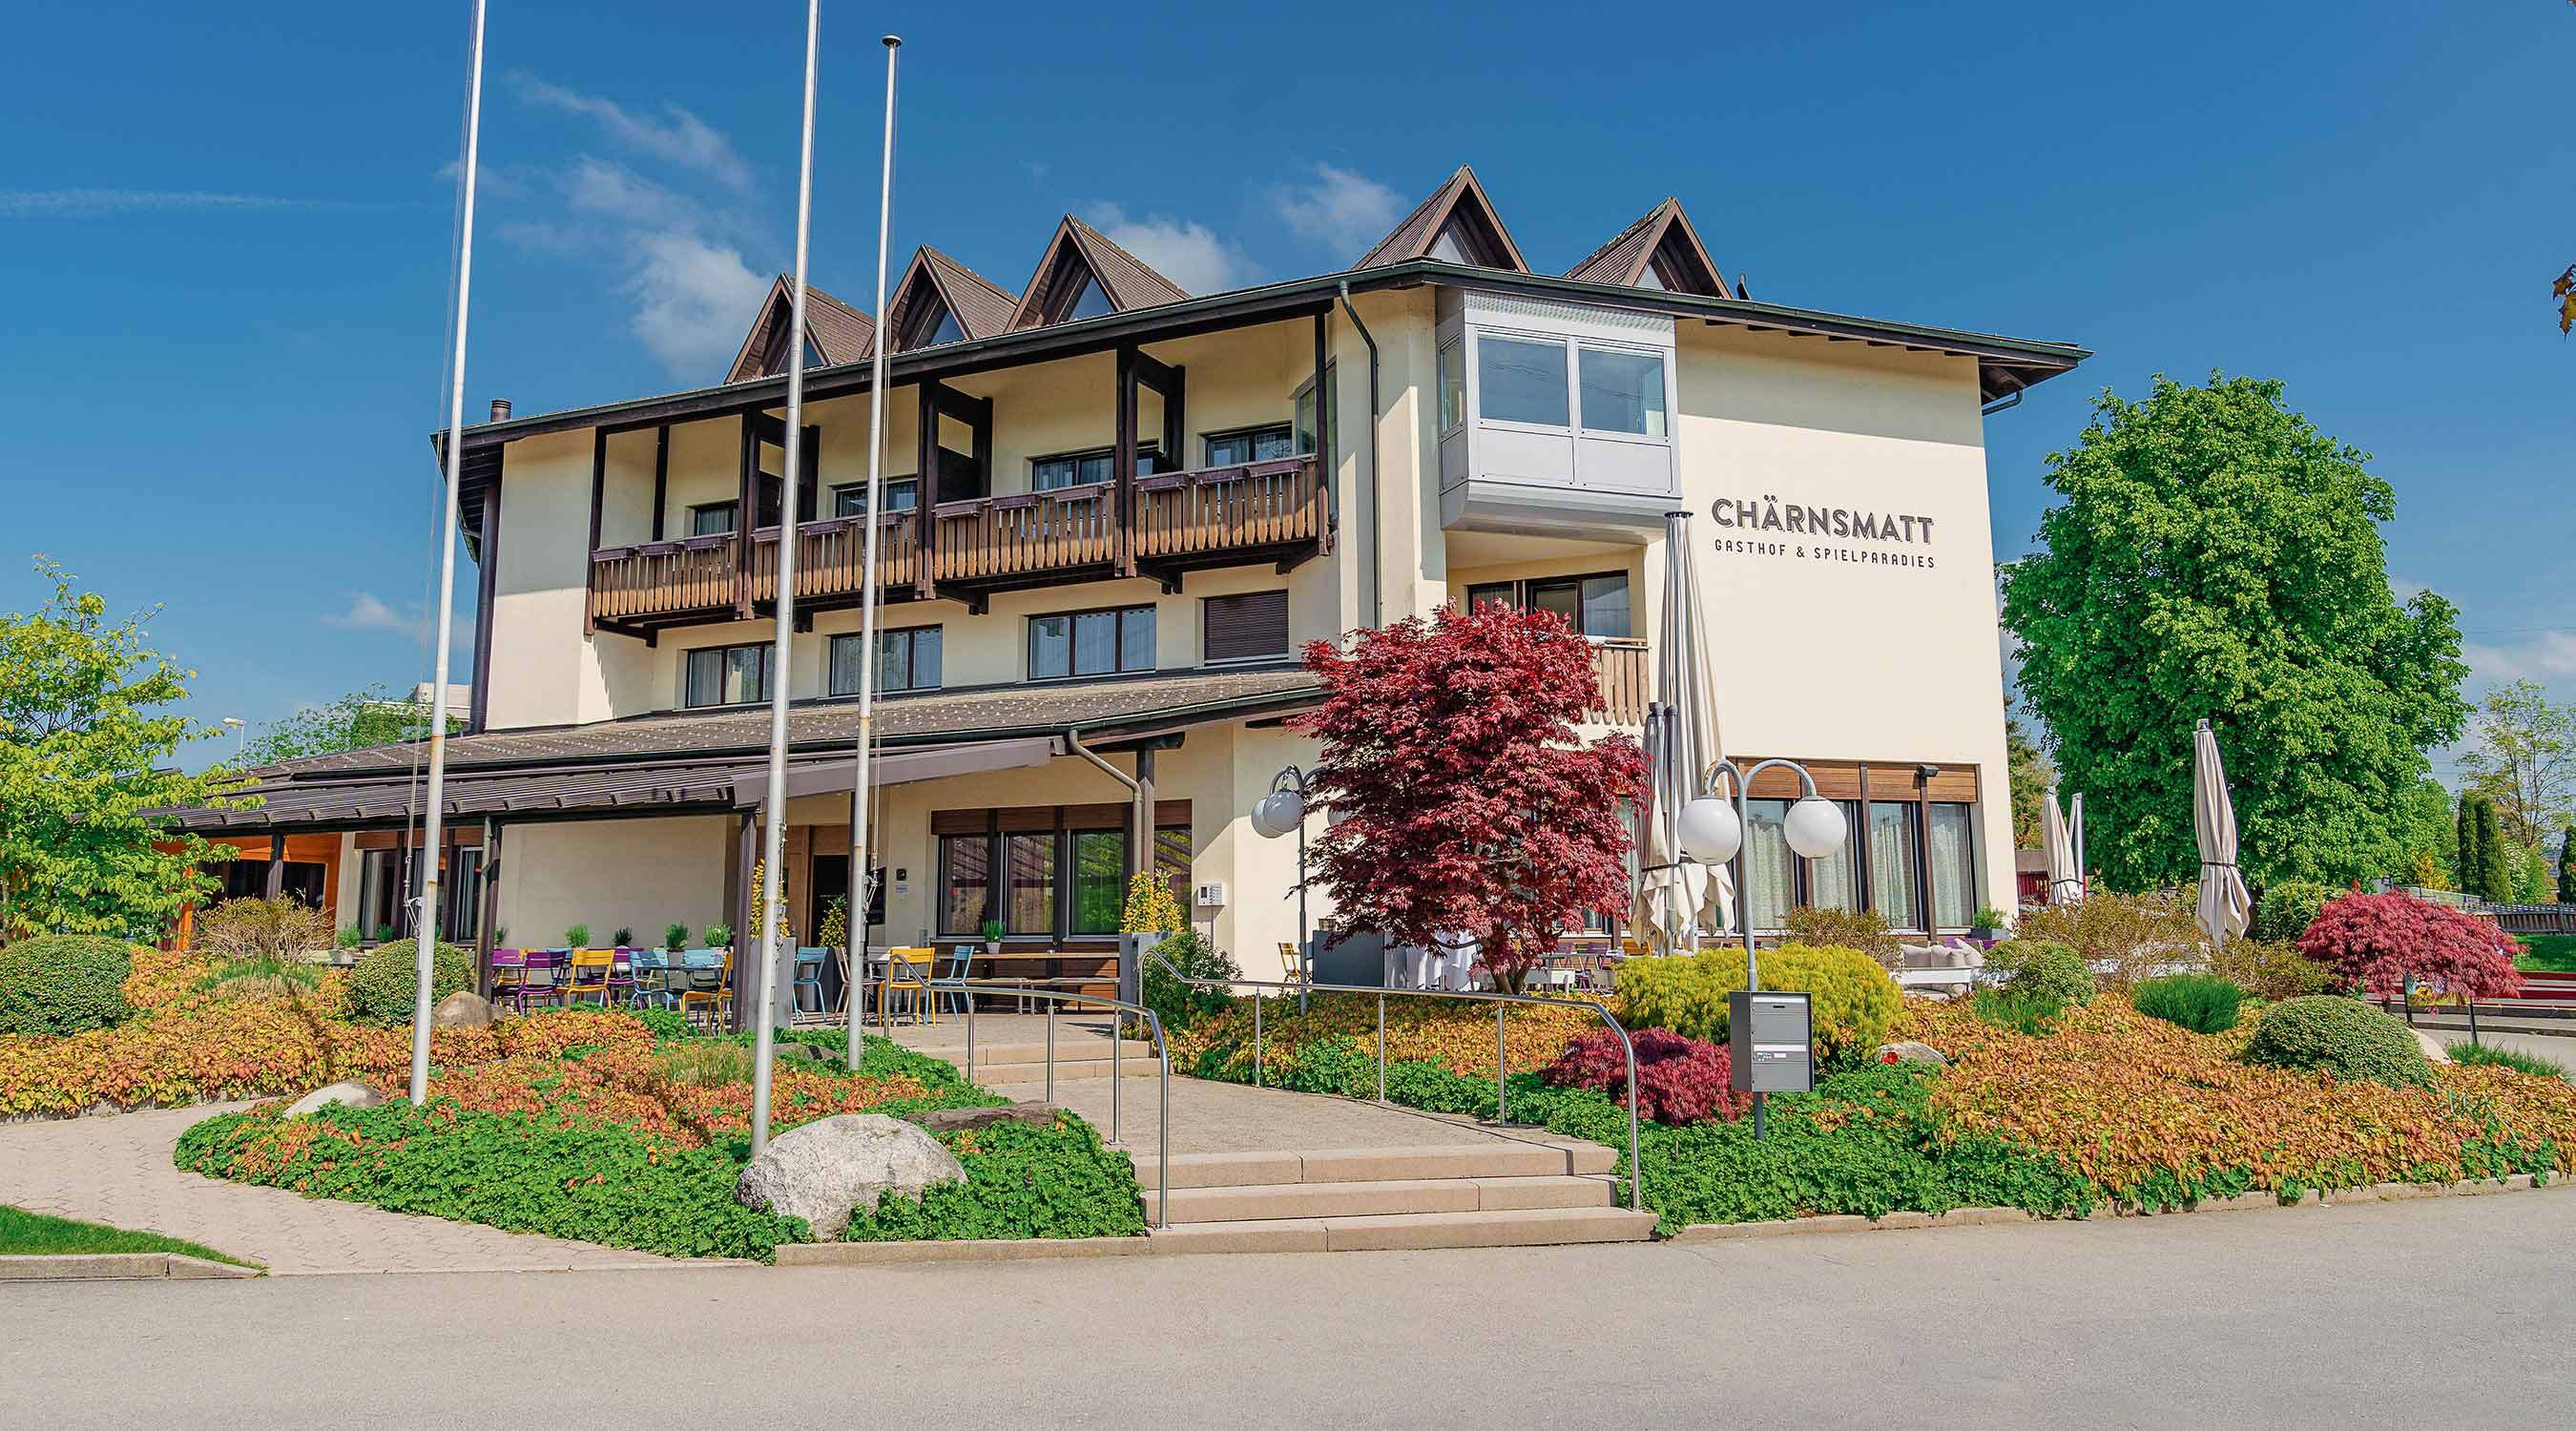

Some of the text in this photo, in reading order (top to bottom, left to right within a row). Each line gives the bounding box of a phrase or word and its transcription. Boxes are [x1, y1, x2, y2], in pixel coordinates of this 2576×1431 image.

[1712, 494, 1934, 545] CHÄRNSMATT
[1714, 539, 1935, 569] GASTHOF & SPIELPARADIES
